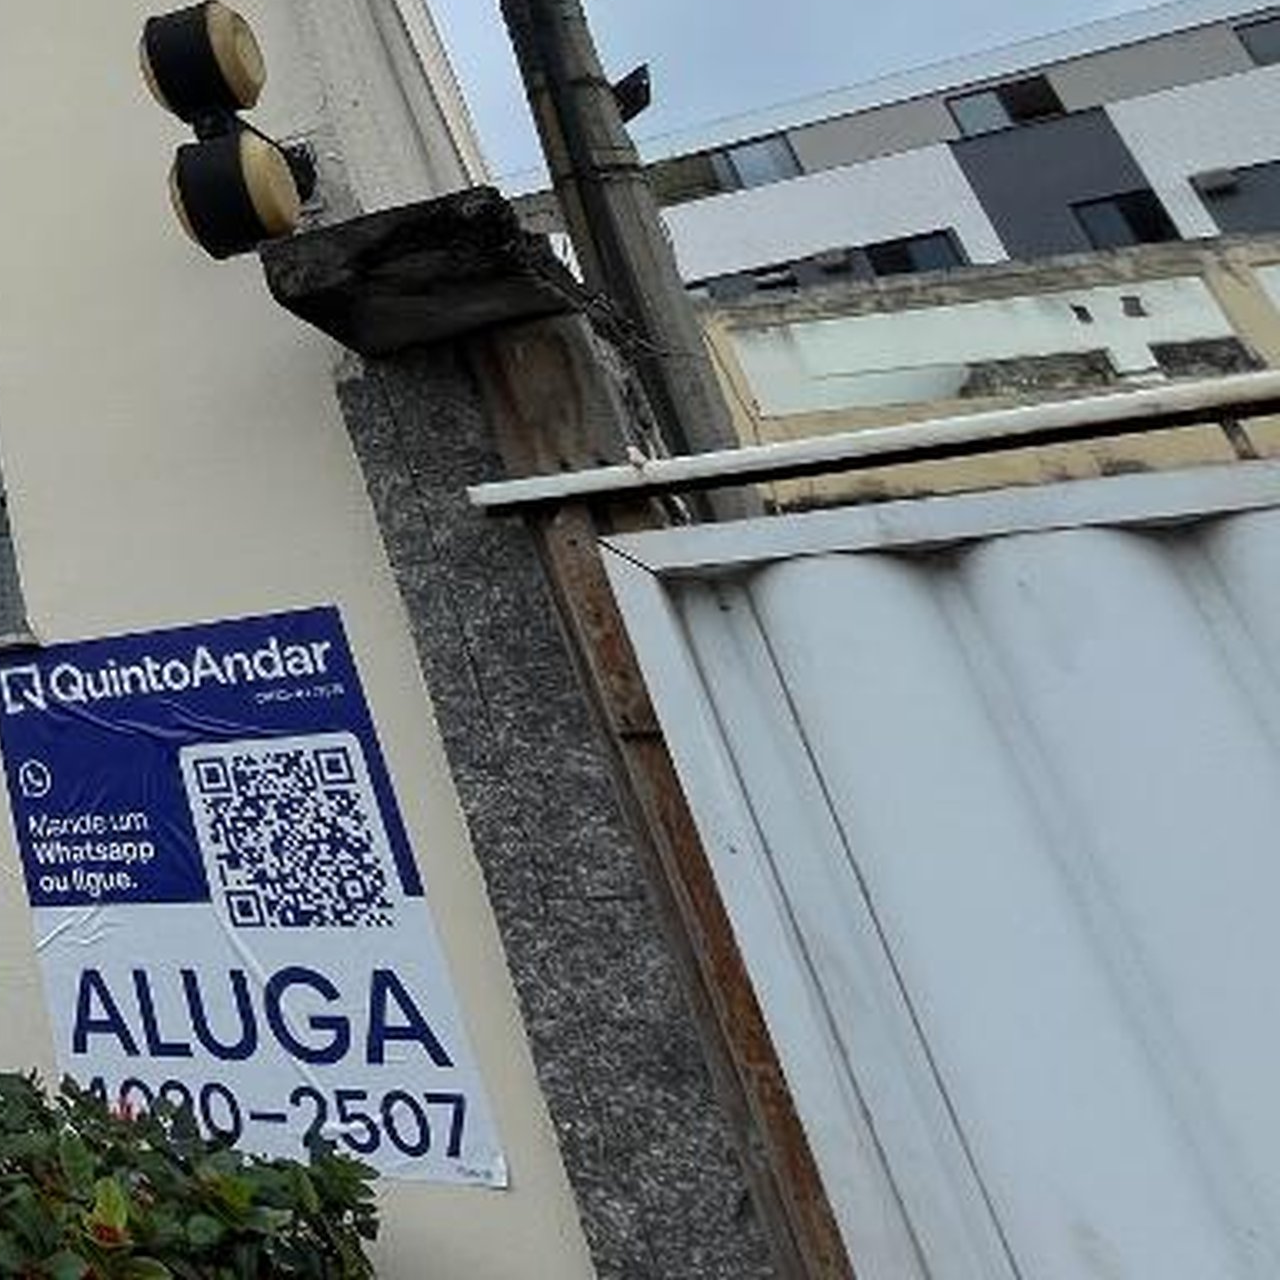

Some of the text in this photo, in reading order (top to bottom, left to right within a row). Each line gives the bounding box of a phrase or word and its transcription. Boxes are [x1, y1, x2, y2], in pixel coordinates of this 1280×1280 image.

[49, 637, 332, 704] QuintoAndar
[32, 840, 155, 865] Whatsapp
[39, 866, 139, 898] ou ligue.
[72, 965, 455, 1068] ALUGA
